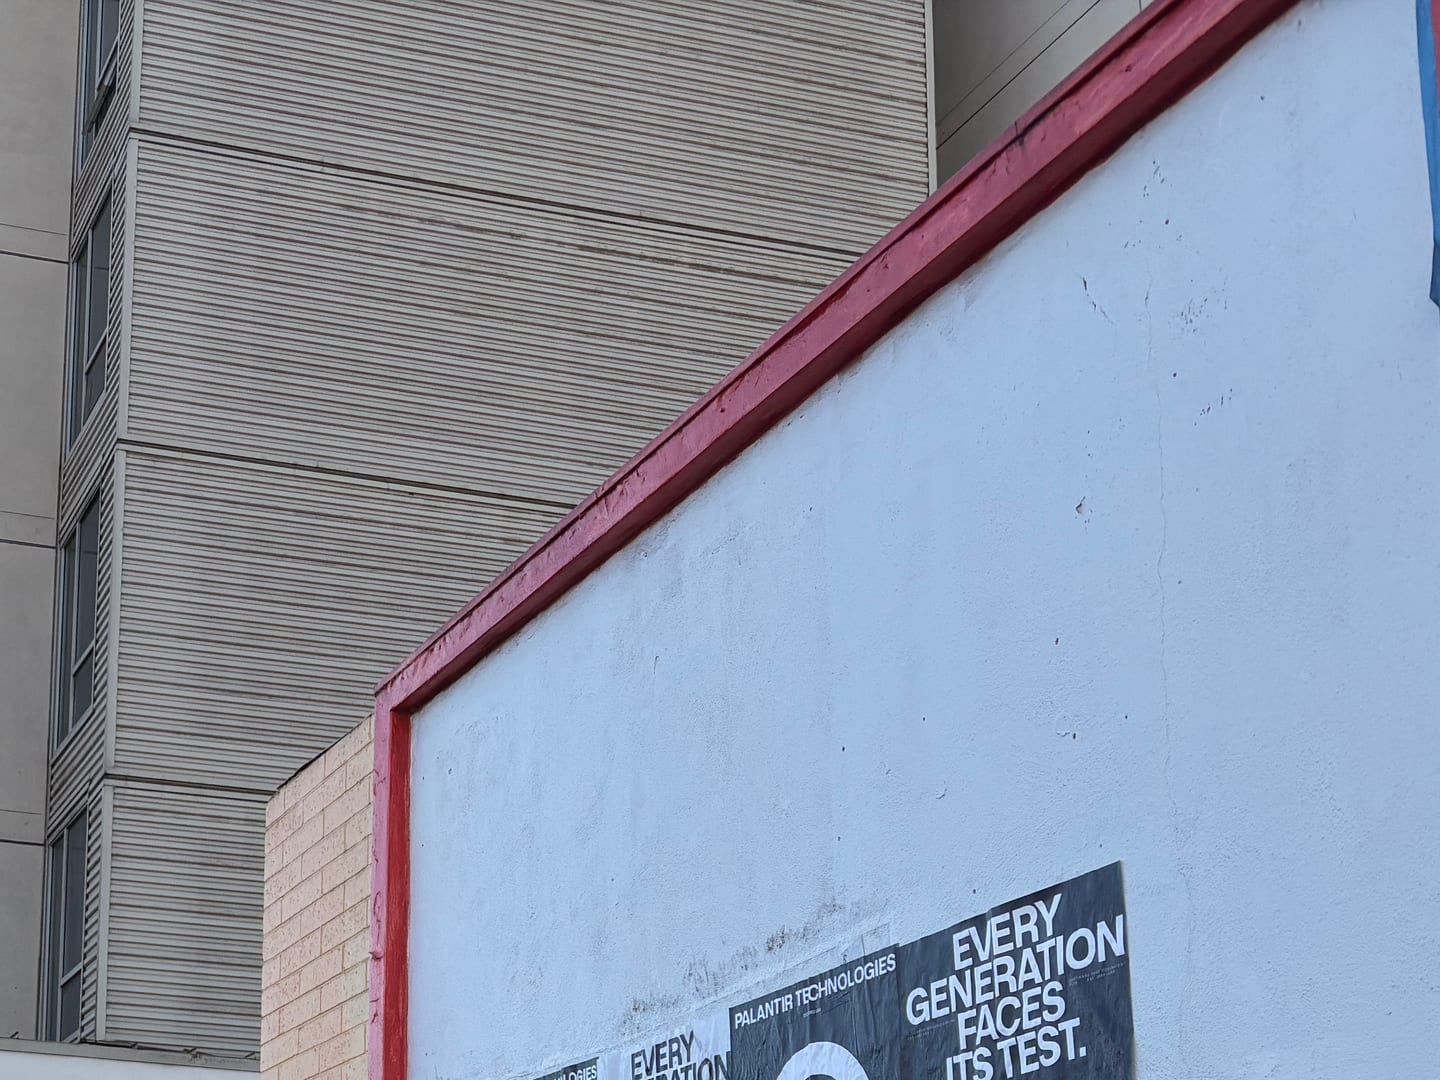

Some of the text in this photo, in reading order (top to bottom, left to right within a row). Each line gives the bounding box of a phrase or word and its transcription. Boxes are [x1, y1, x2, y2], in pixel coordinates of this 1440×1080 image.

[952, 893, 1062, 971] EVERY
[734, 953, 897, 1030] PALANTIR TECHNOLOGIES
[906, 914, 1126, 1026] GENERATION
[957, 980, 1066, 1050] FACES
[997, 1017, 1087, 1079] TEST.
[631, 1030, 694, 1080] EVERY
